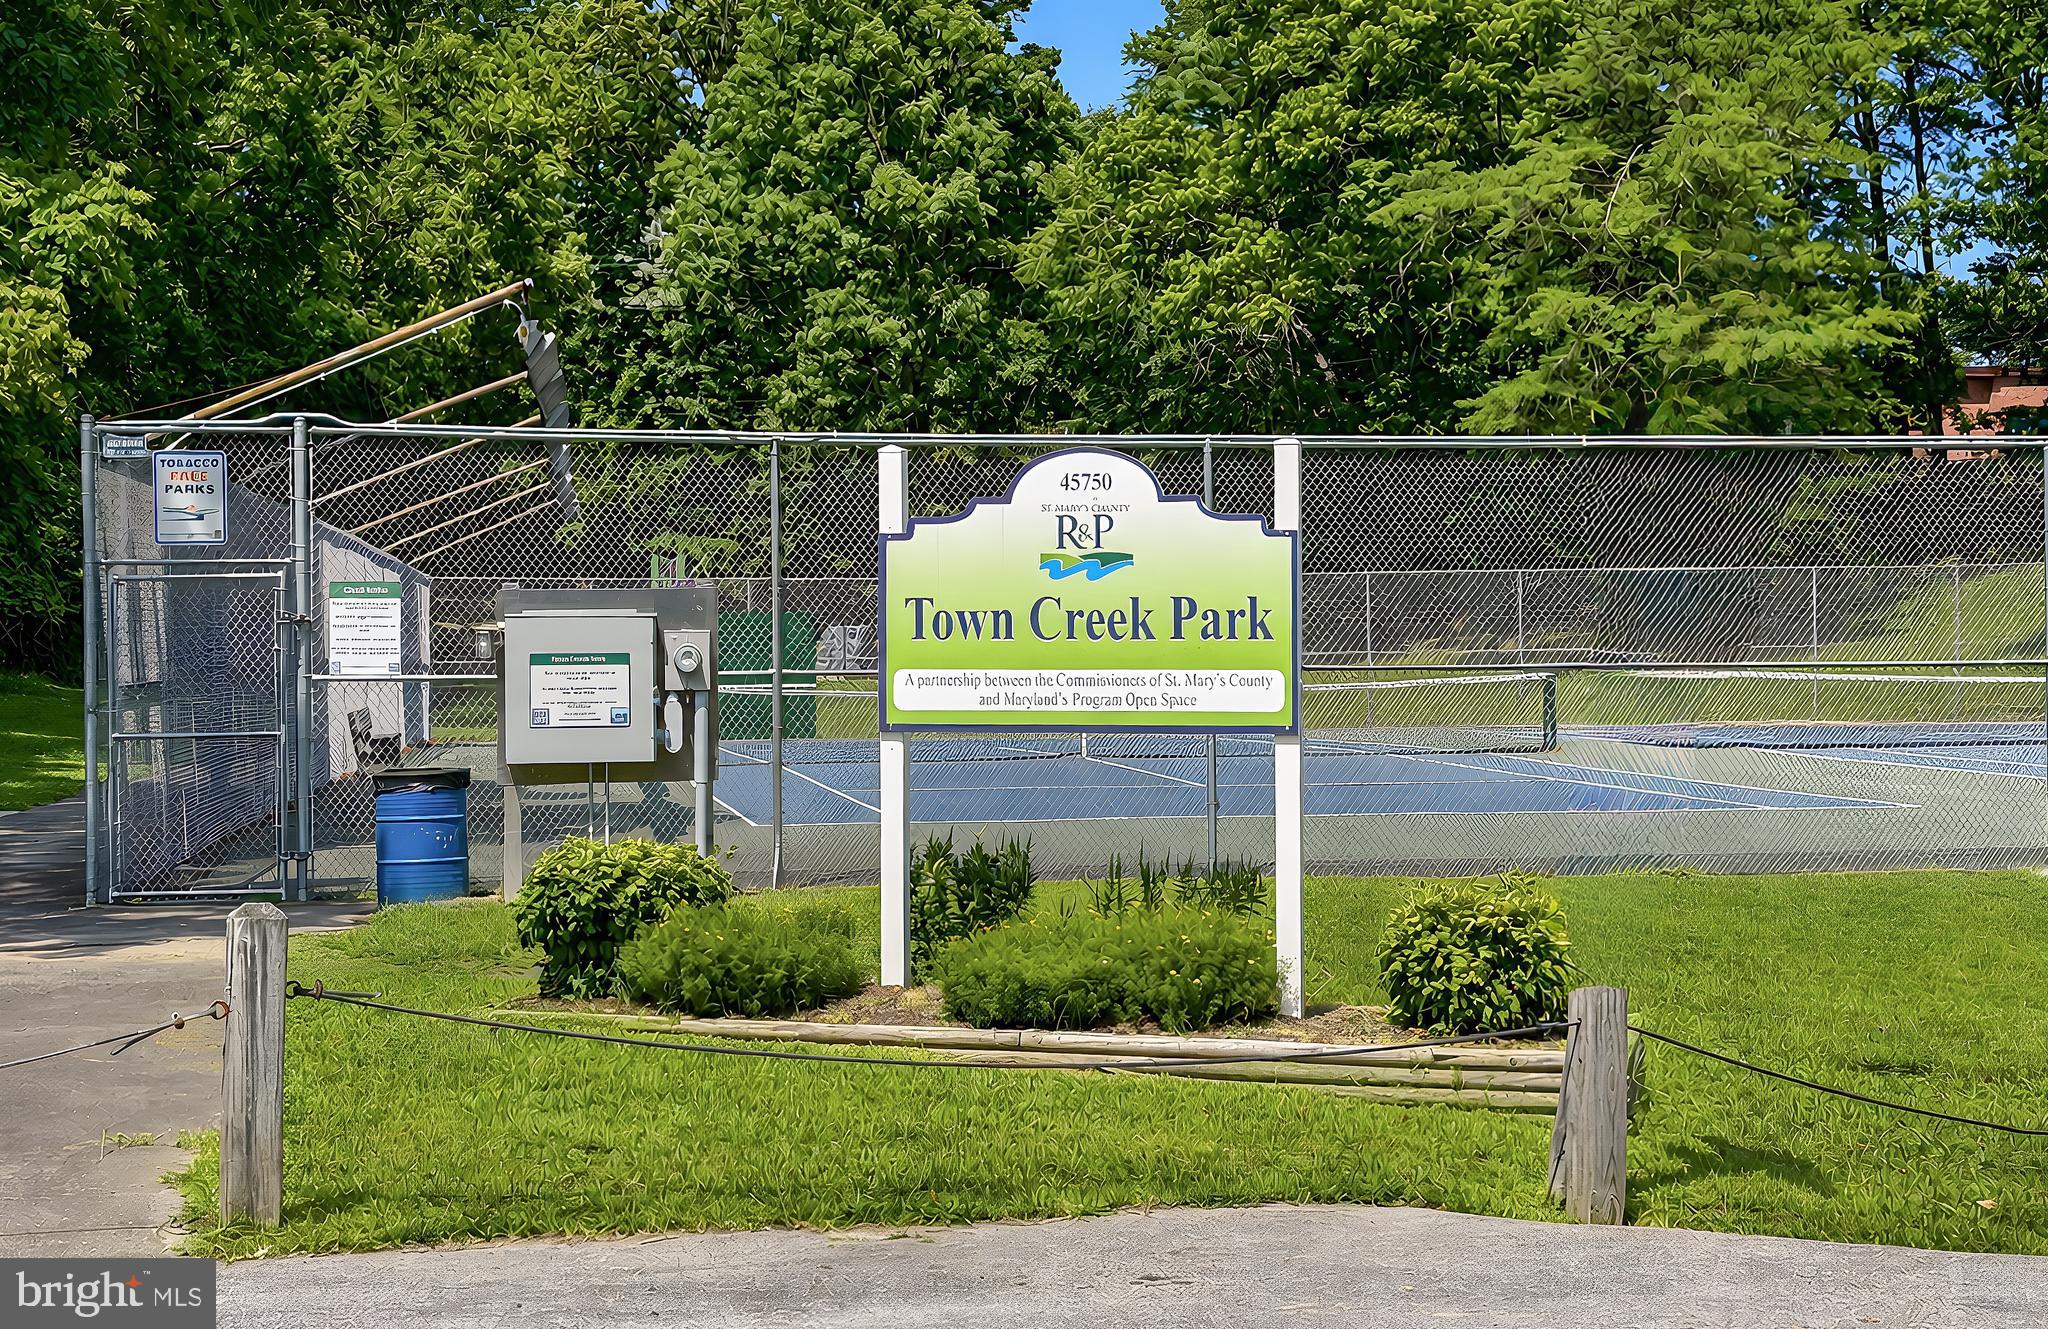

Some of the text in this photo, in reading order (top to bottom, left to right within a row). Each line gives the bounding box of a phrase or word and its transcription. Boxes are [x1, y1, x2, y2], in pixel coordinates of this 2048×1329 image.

[160, 459, 219, 468] TOBACCO
[165, 484, 215, 494] PARKS
[1060, 472, 1112, 491] 45750
[904, 596, 1275, 641] Town Creek Park
[905, 672, 1273, 690] A partnership between the Commissioners of St. Mary's County
[979, 692, 1197, 709] and Maryland's Program Open Space
